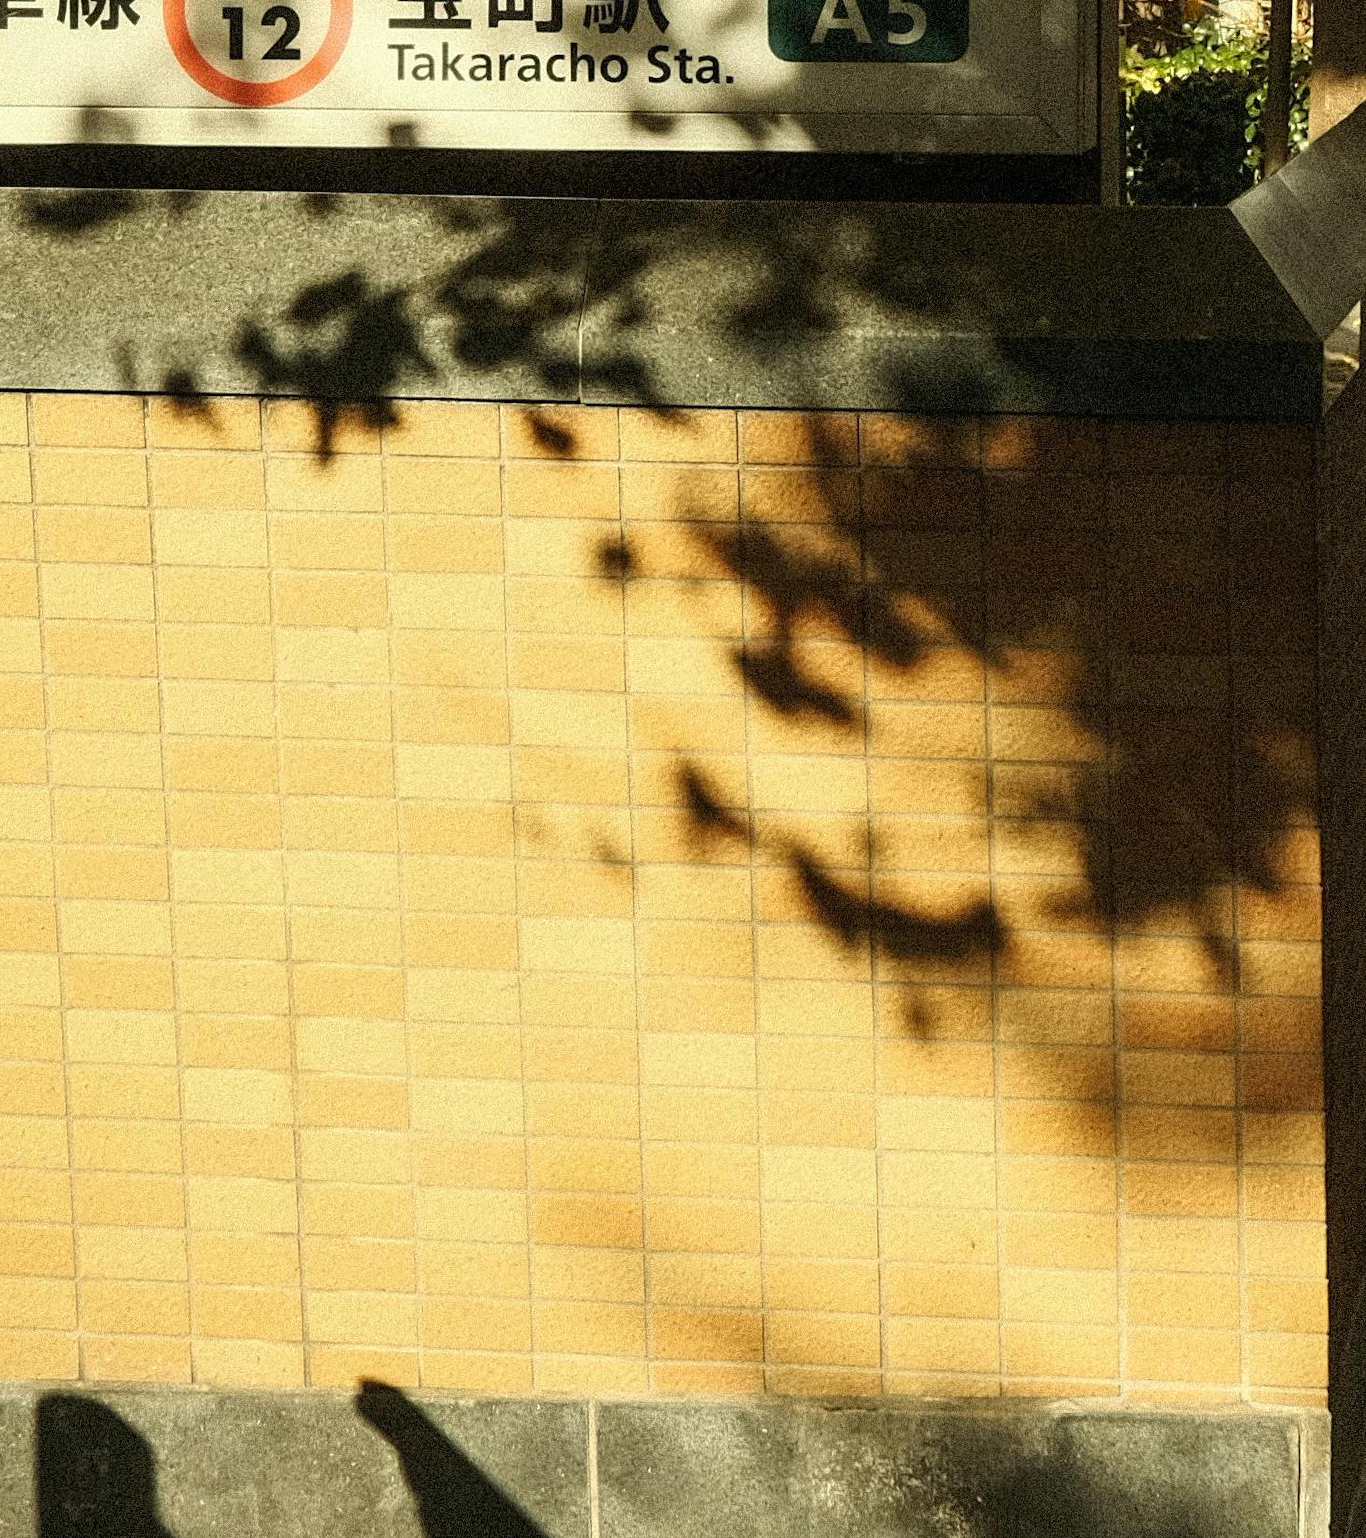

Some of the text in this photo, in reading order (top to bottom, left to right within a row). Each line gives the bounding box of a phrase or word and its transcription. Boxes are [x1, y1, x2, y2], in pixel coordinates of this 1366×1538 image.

[221, 5, 302, 60] 12
[388, 42, 735, 85] Takaracho Sta.
